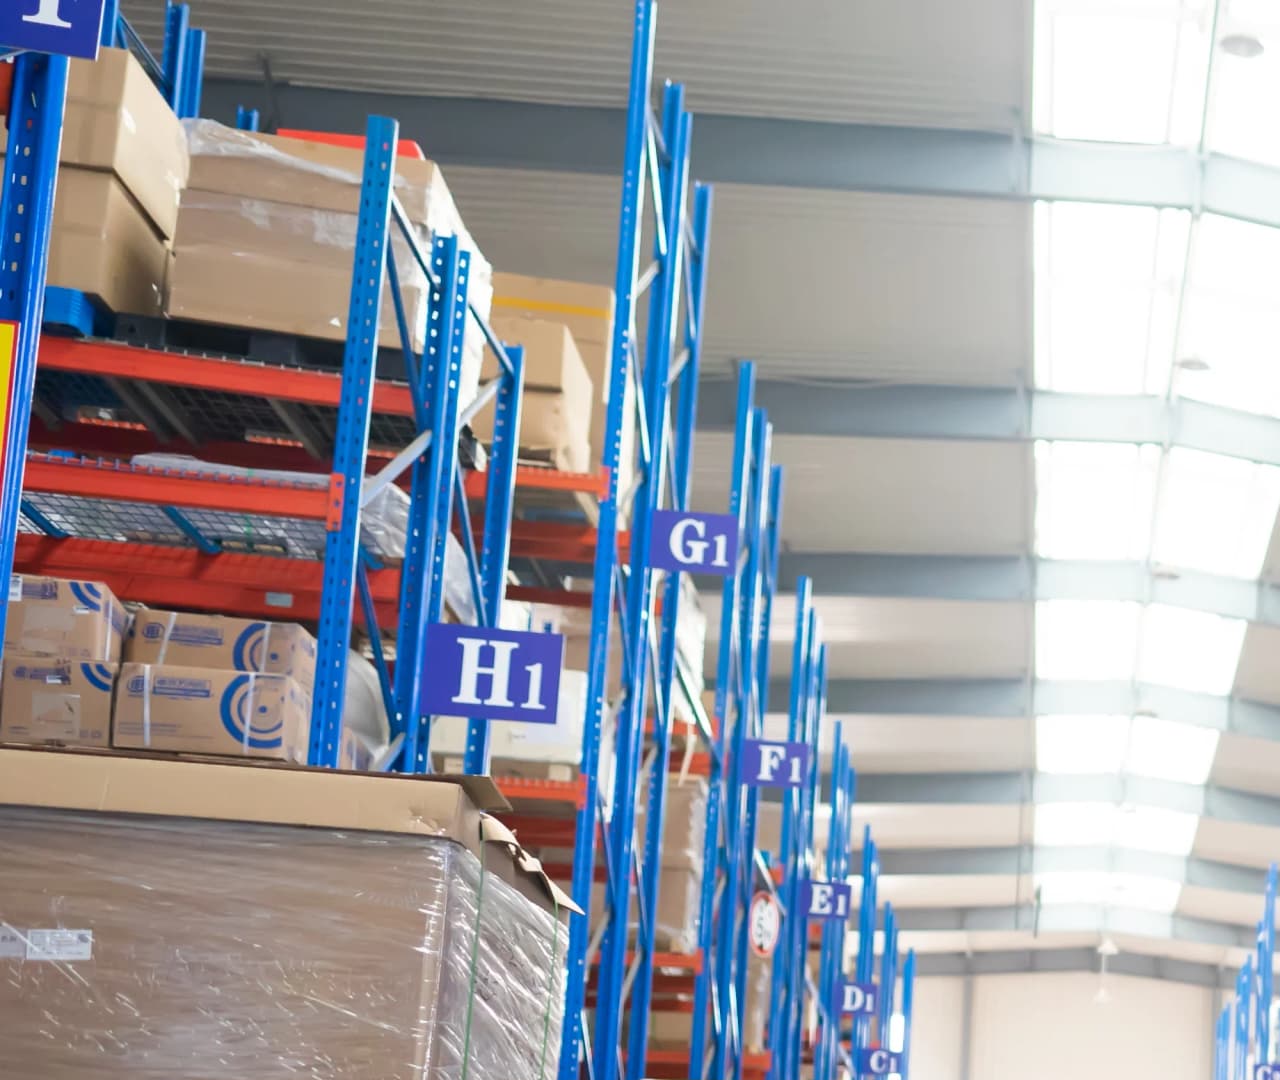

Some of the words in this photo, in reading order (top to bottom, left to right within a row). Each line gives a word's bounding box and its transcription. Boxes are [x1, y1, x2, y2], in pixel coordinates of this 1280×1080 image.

[668, 518, 730, 568] G1
[450, 636, 547, 711] H1
[756, 744, 802, 784] F1
[808, 881, 848, 917] E1
[842, 984, 875, 1014] D1
[869, 1050, 898, 1074] C1
